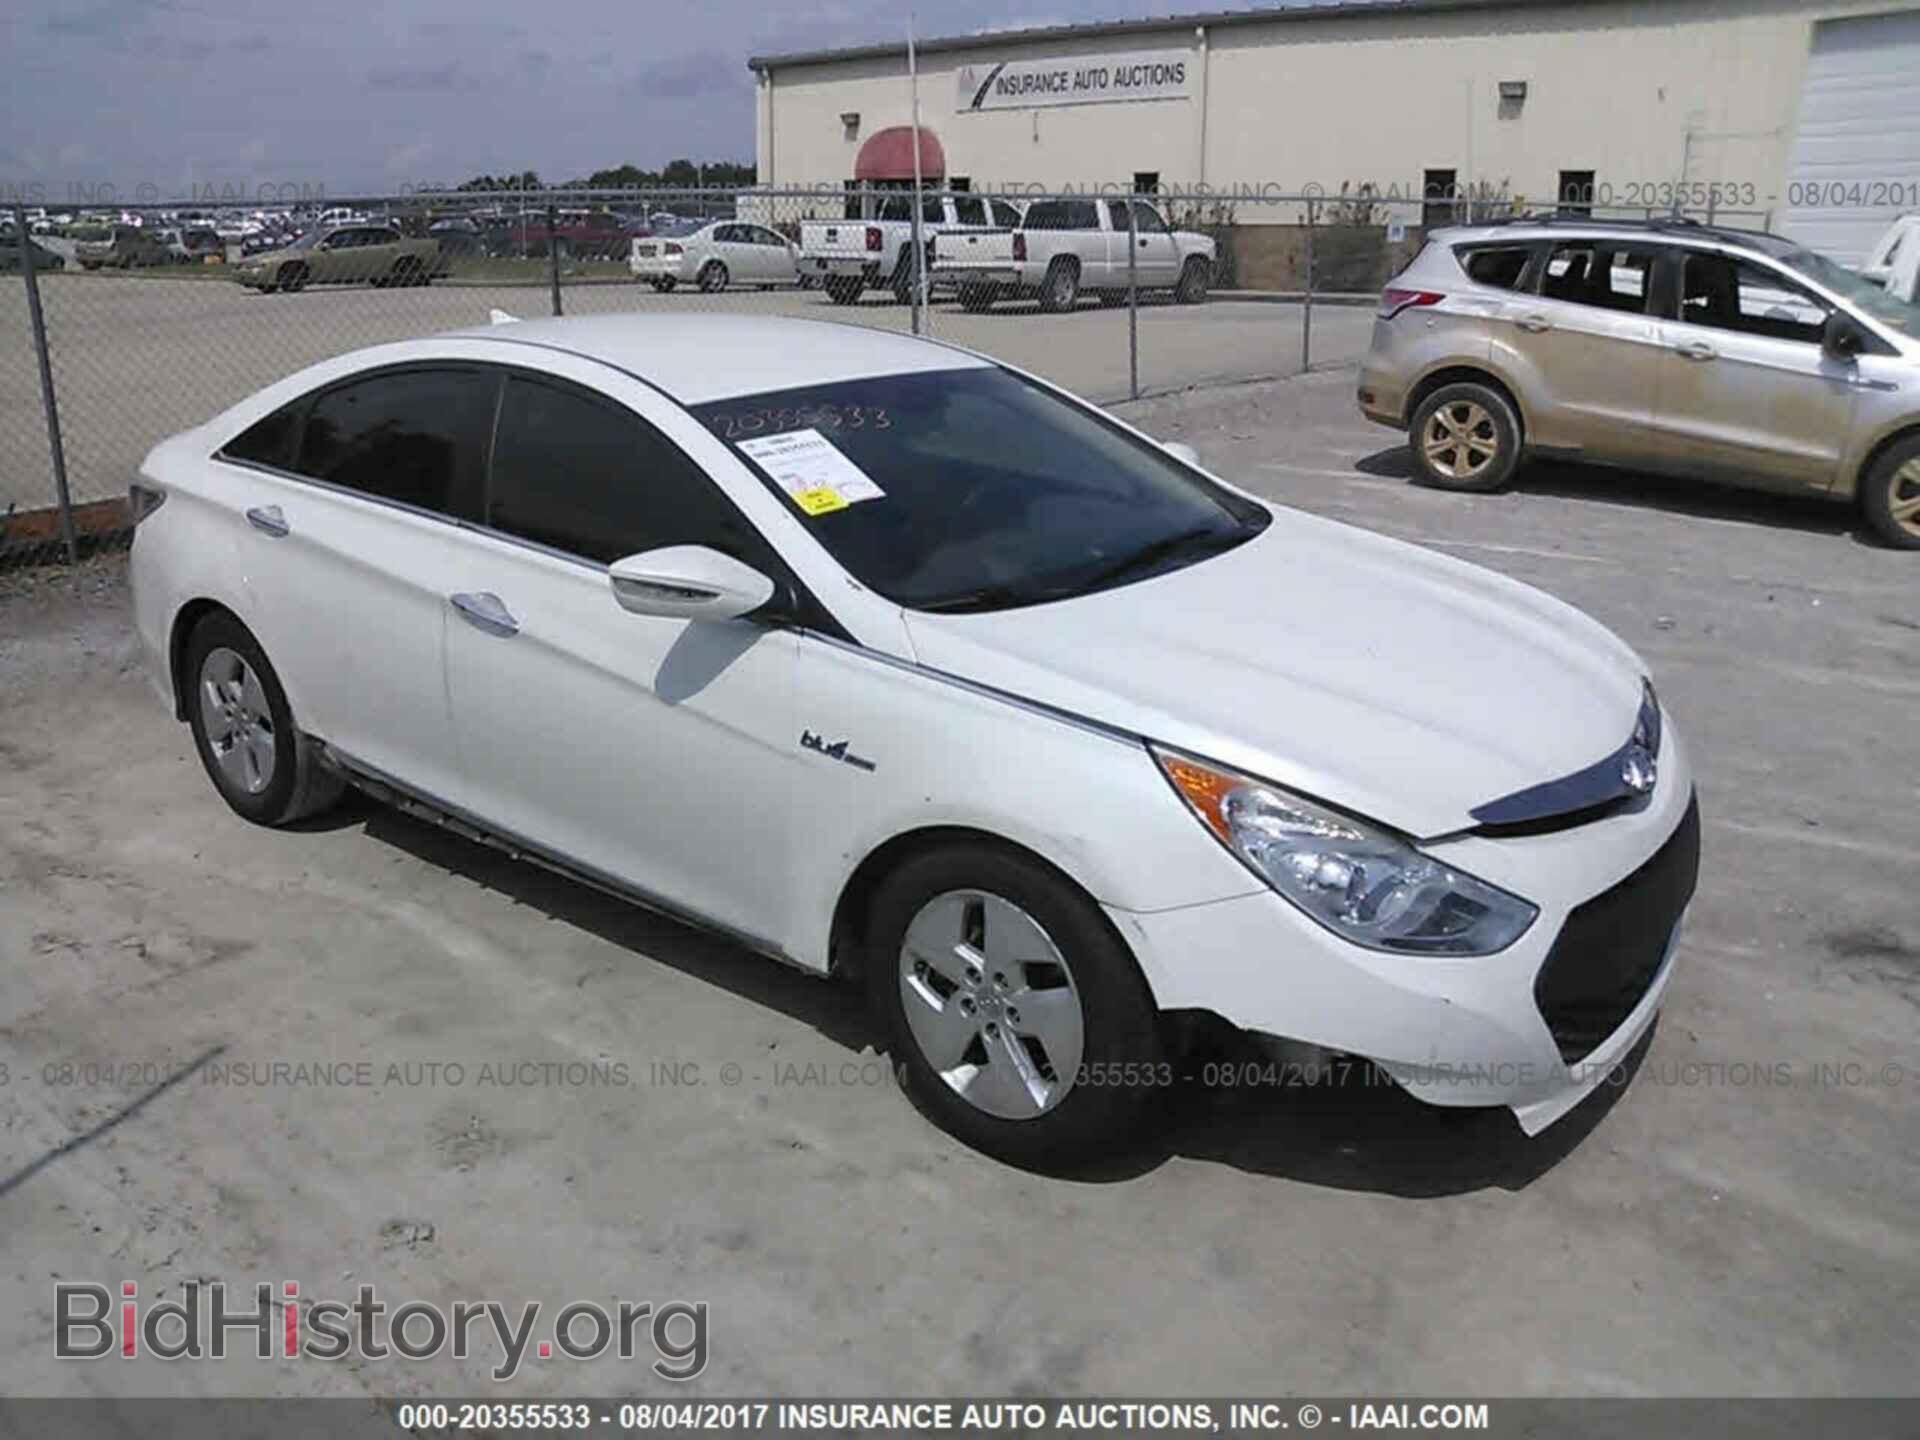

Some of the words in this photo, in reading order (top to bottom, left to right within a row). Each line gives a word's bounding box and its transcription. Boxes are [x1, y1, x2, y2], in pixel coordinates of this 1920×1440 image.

[996, 71, 1068, 96] INSURANCE
[1073, 67, 1108, 91] AUTO
[1113, 61, 1186, 88] AUCTIONS
